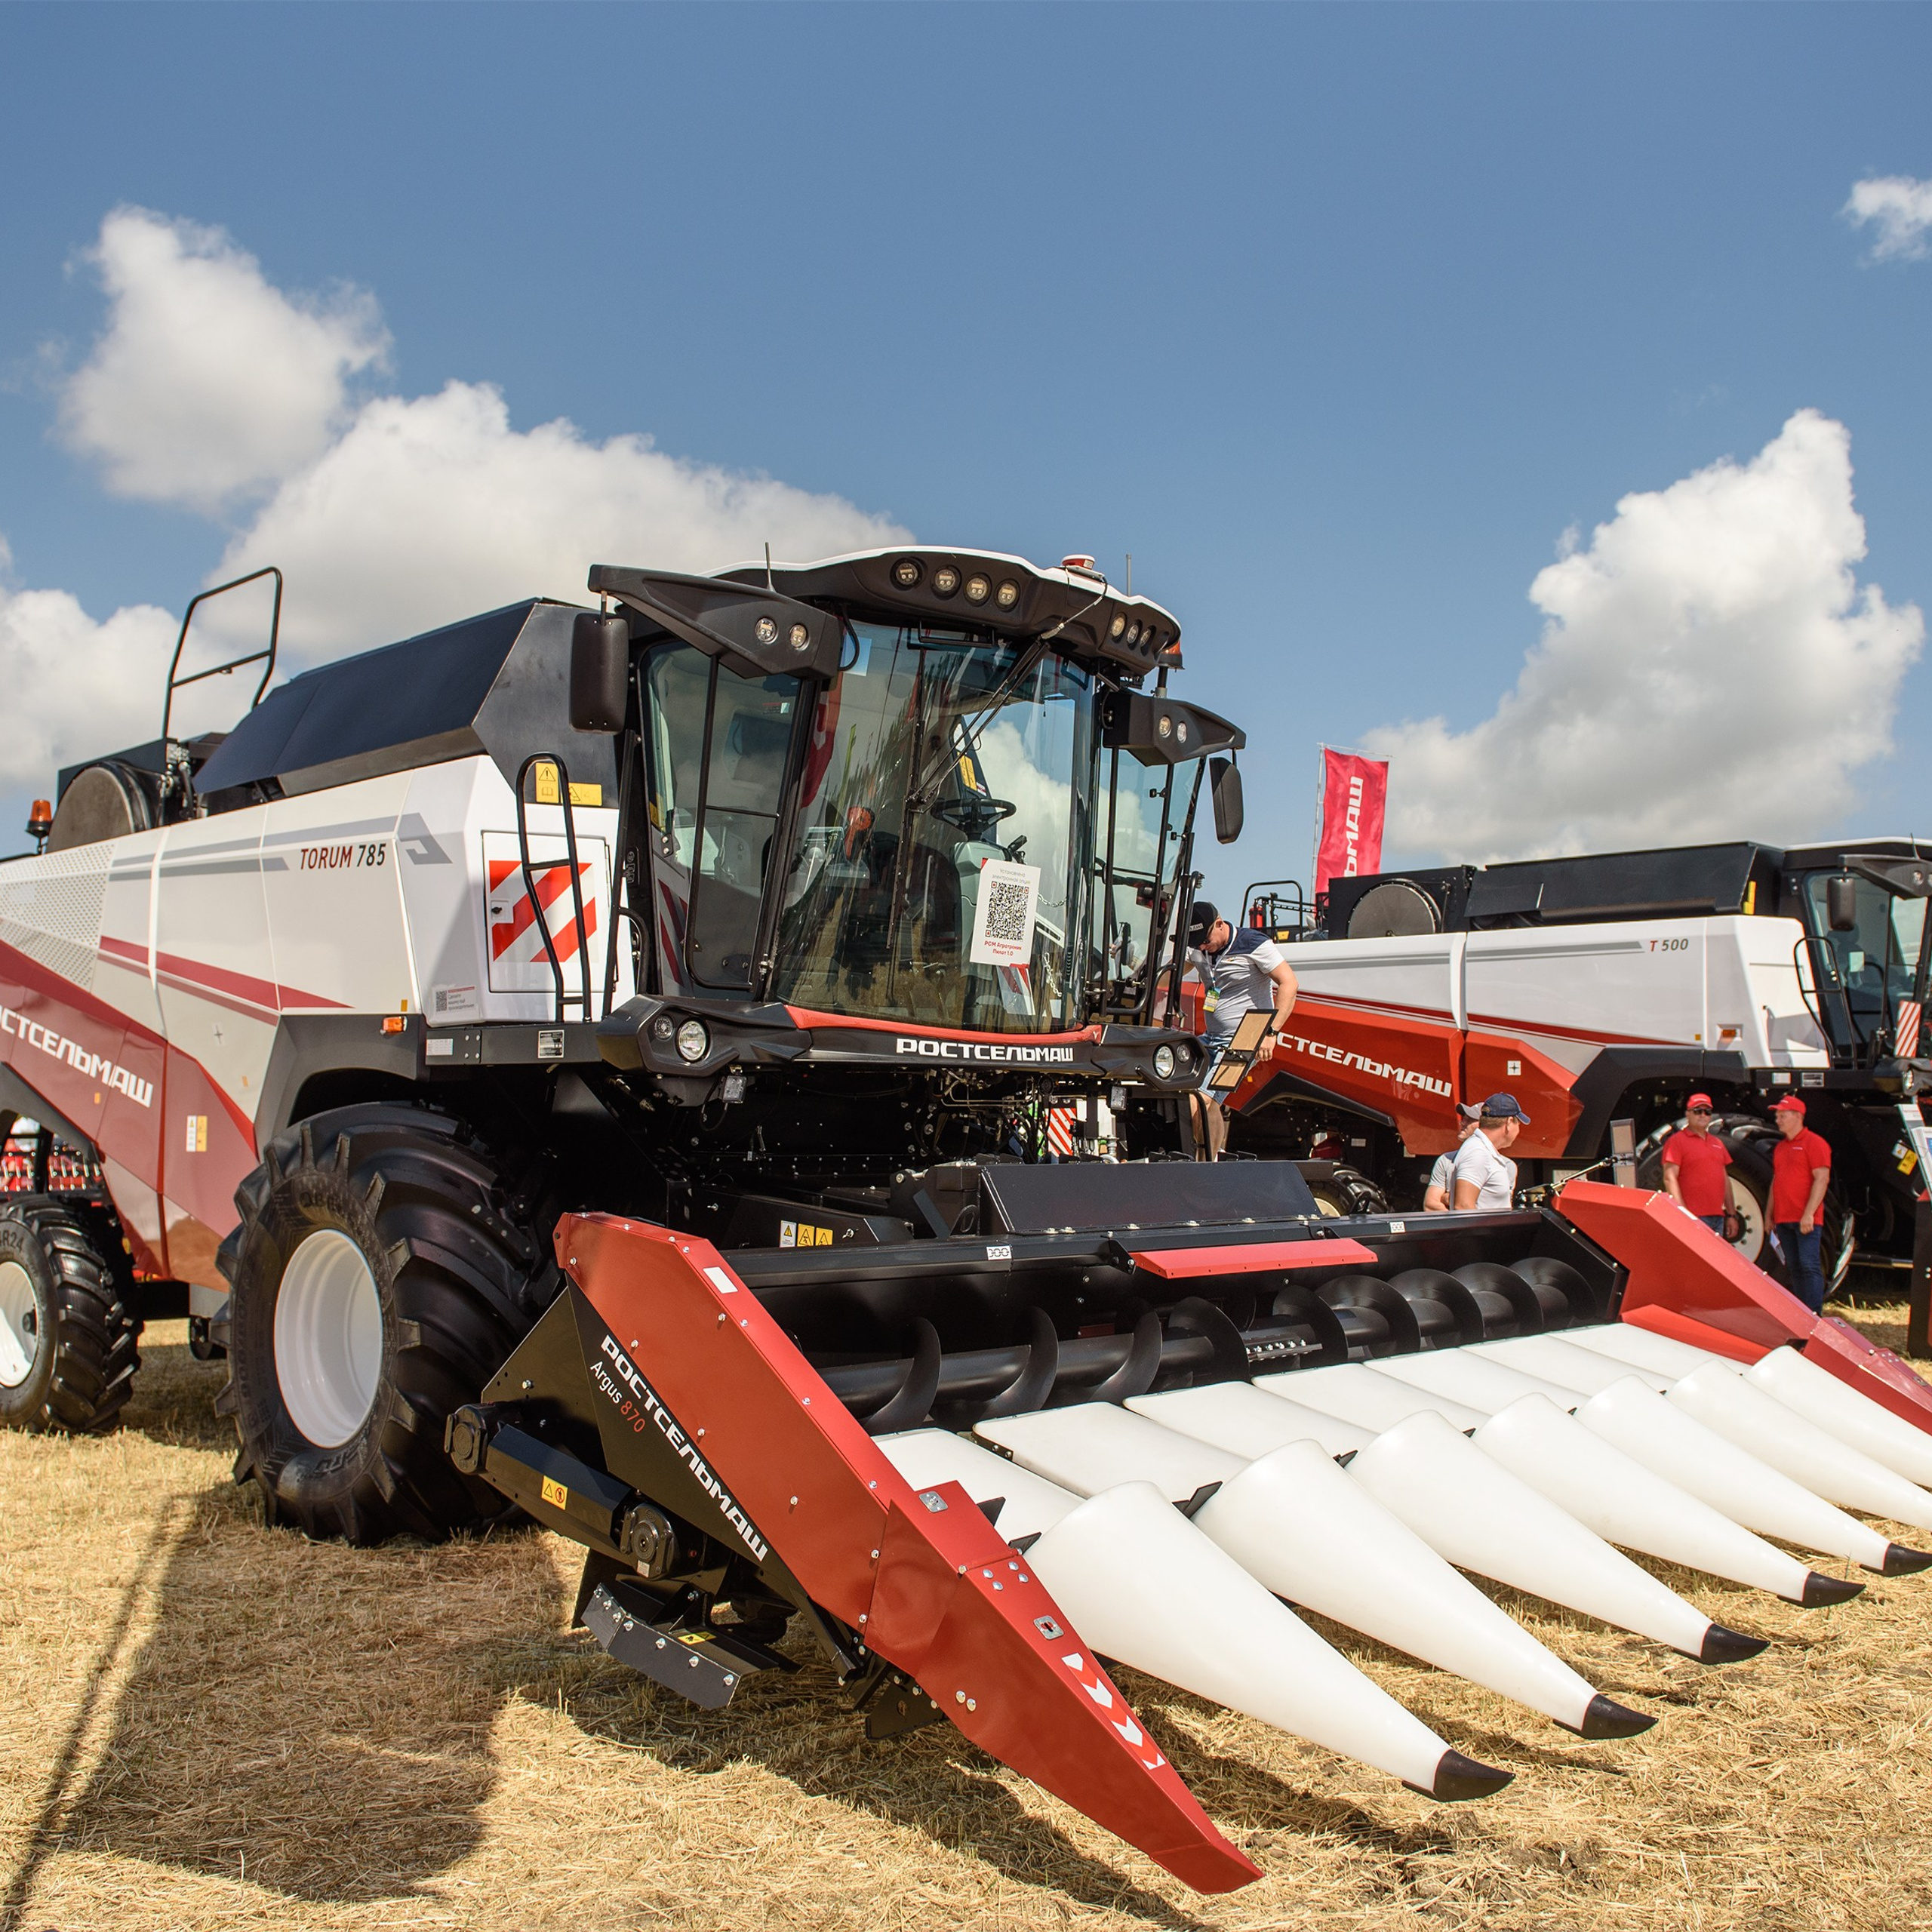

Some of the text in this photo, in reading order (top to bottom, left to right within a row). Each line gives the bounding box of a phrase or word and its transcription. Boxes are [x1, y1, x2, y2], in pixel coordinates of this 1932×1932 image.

[300, 843, 386, 870] TORUM 785
[1650, 938, 1689, 952] T 500
[0, 1004, 154, 1109] СТСЕЛЬМАШ
[896, 1038, 1074, 1062] РОСТСЕЛЬМАШ
[589, 1361, 646, 1432] Argus 870
[601, 1334, 768, 1562] РОСТСЕЛЬМАШ
